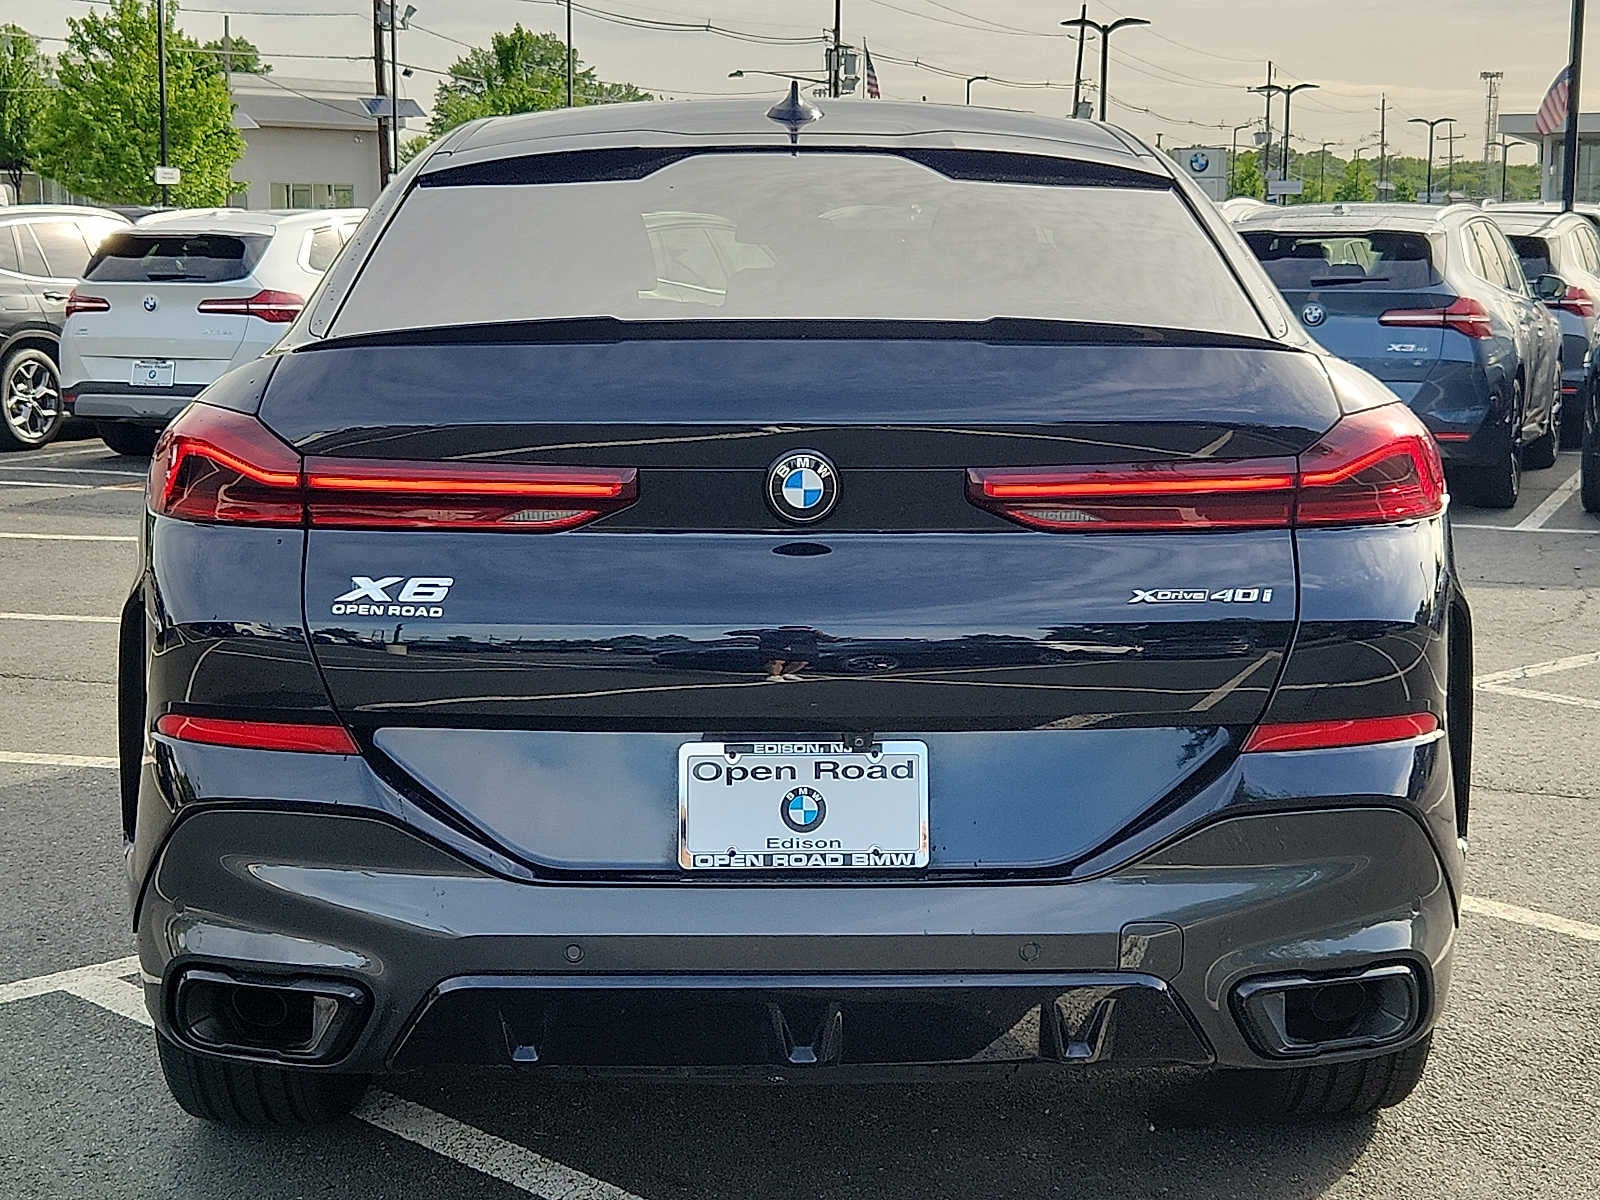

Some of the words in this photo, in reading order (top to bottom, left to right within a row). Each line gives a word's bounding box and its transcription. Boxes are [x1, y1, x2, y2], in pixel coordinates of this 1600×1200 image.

[776, 457, 831, 479] BMW
[333, 576, 454, 602] X6
[331, 604, 384, 615] OPEN
[387, 605, 443, 617] ROAD
[753, 743, 824, 753] EDISON,
[692, 761, 797, 785] Open
[814, 760, 914, 780] Road
[785, 787, 822, 802] BMW
[766, 837, 841, 849] Edison
[694, 854, 764, 867] OPEN
[772, 853, 844, 867] ROAD
[851, 852, 914, 866] BMW
